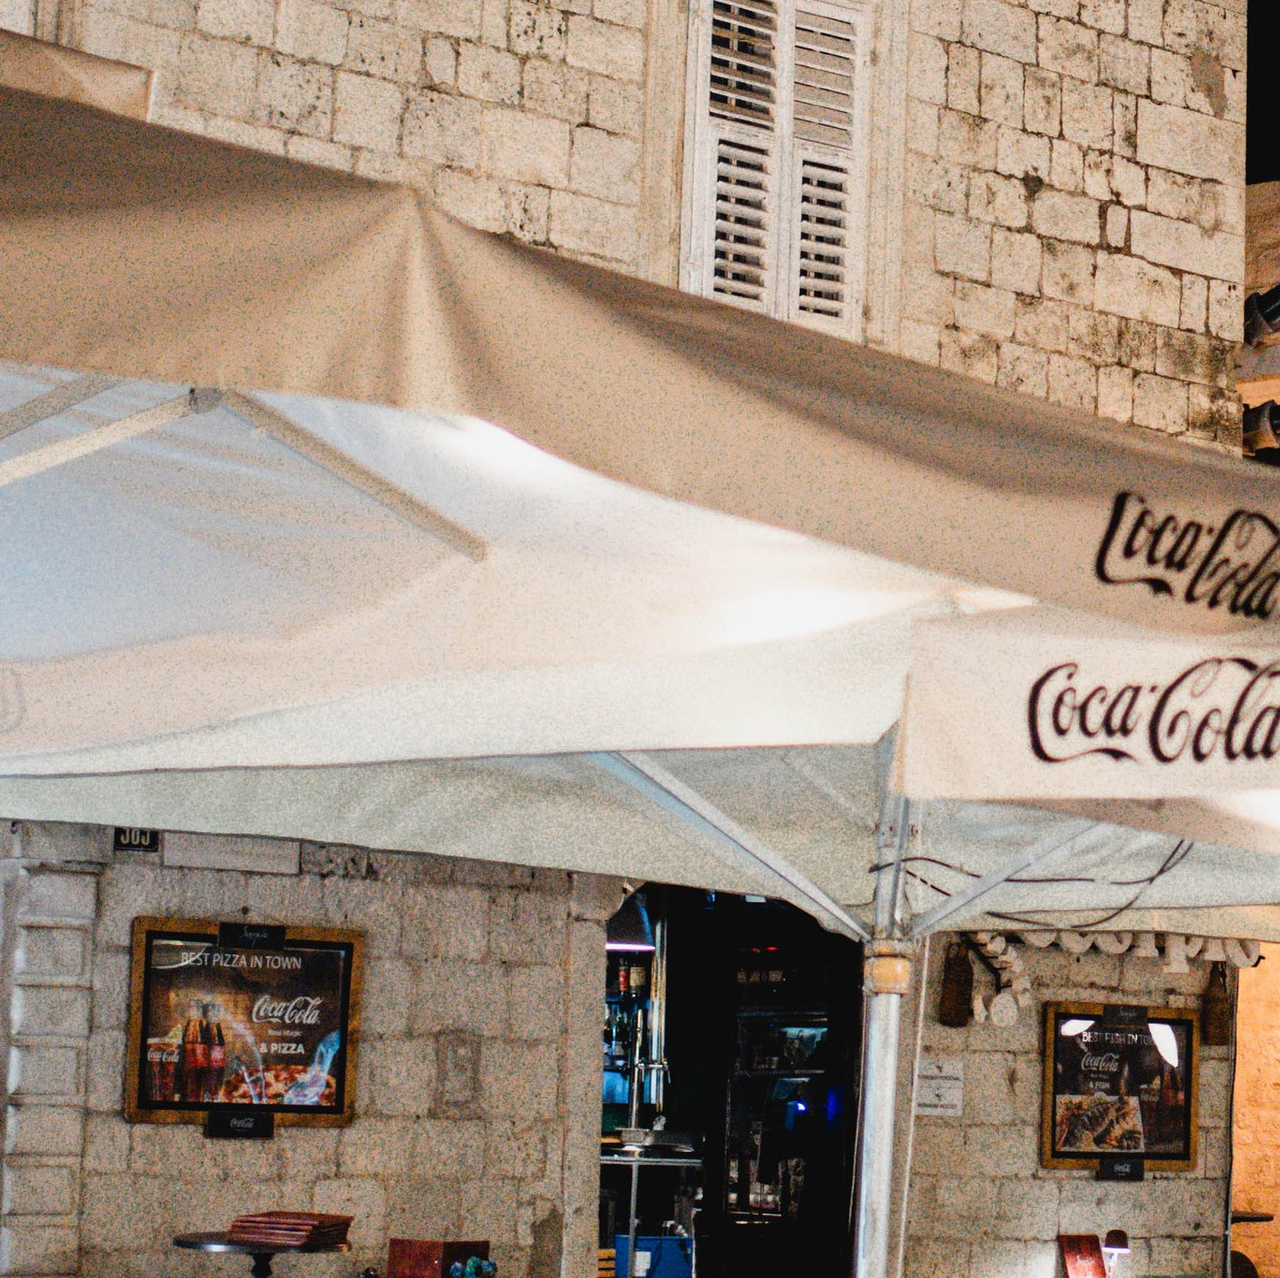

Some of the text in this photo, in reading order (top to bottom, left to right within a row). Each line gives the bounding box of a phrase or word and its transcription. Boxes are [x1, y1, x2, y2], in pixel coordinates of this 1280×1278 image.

[181, 952, 302, 970] BEST PIZZA IN TOWN
[270, 1043, 305, 1054] PIZZA
